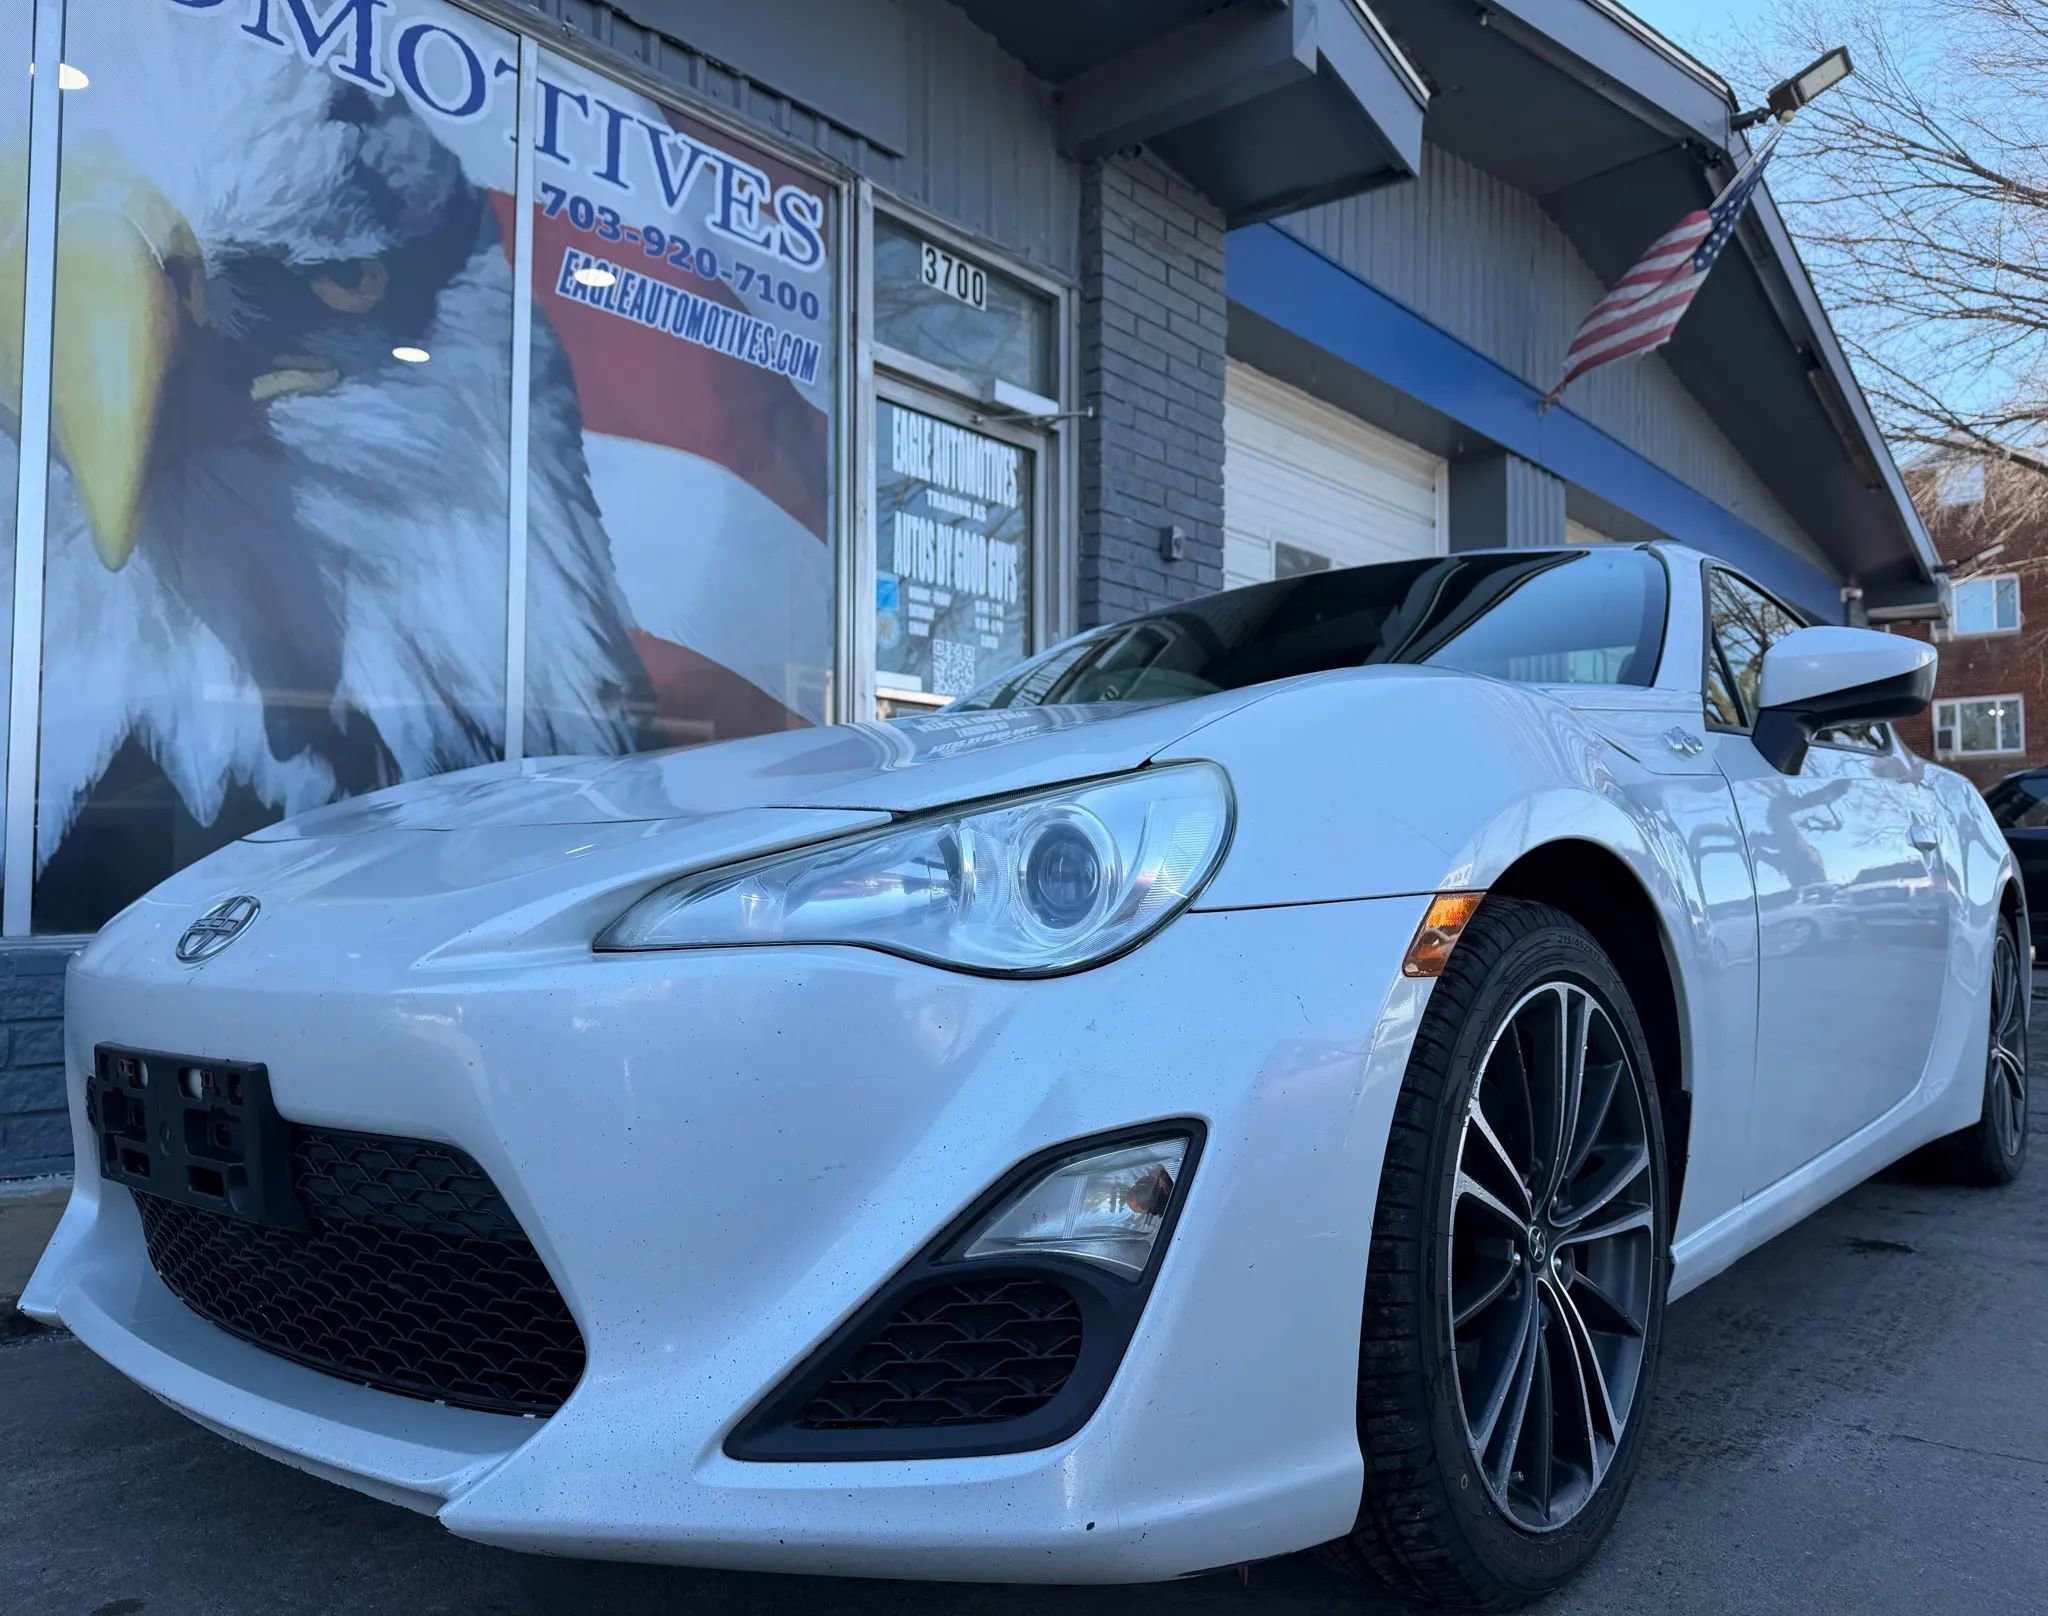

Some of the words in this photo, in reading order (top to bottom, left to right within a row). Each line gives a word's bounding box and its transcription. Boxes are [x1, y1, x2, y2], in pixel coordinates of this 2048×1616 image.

[540, 182, 820, 321] 703-920-7100
[924, 246, 984, 307] 3700
[557, 249, 822, 383] EAGLEAUTOMOTIVES.COM
[892, 406, 931, 482] EAGLE
[932, 420, 1018, 509] AUTOMOTIVES
[893, 510, 935, 584] AUTOS
[936, 522, 954, 588] BY
[954, 527, 987, 596] GOOD
